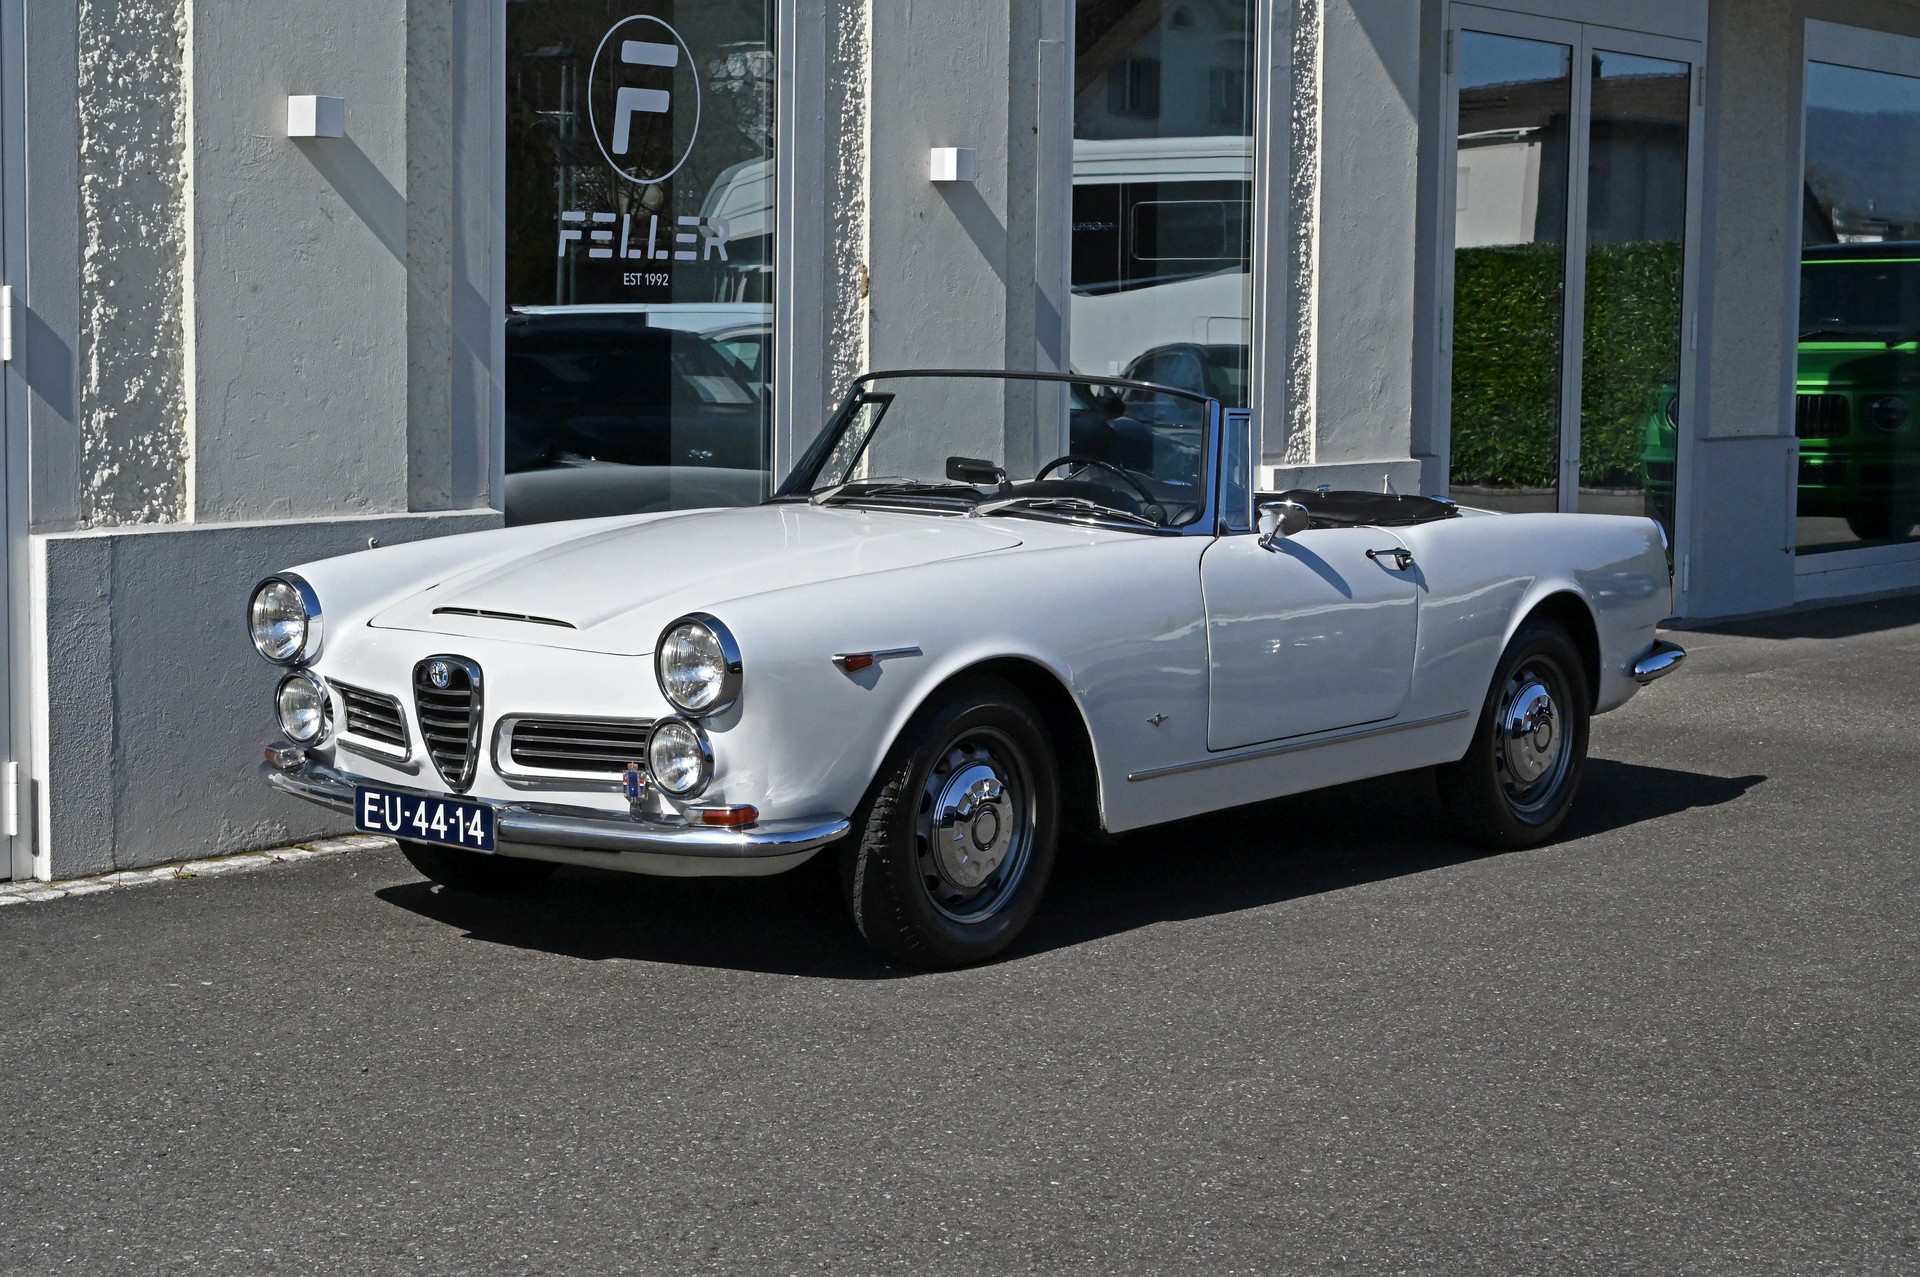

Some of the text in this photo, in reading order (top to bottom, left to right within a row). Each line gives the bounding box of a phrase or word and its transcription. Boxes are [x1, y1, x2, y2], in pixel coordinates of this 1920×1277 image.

[612, 40, 679, 155] F
[558, 211, 730, 261] FELLER
[623, 273, 669, 286] EST 1992
[364, 792, 485, 846] EU-44-14
